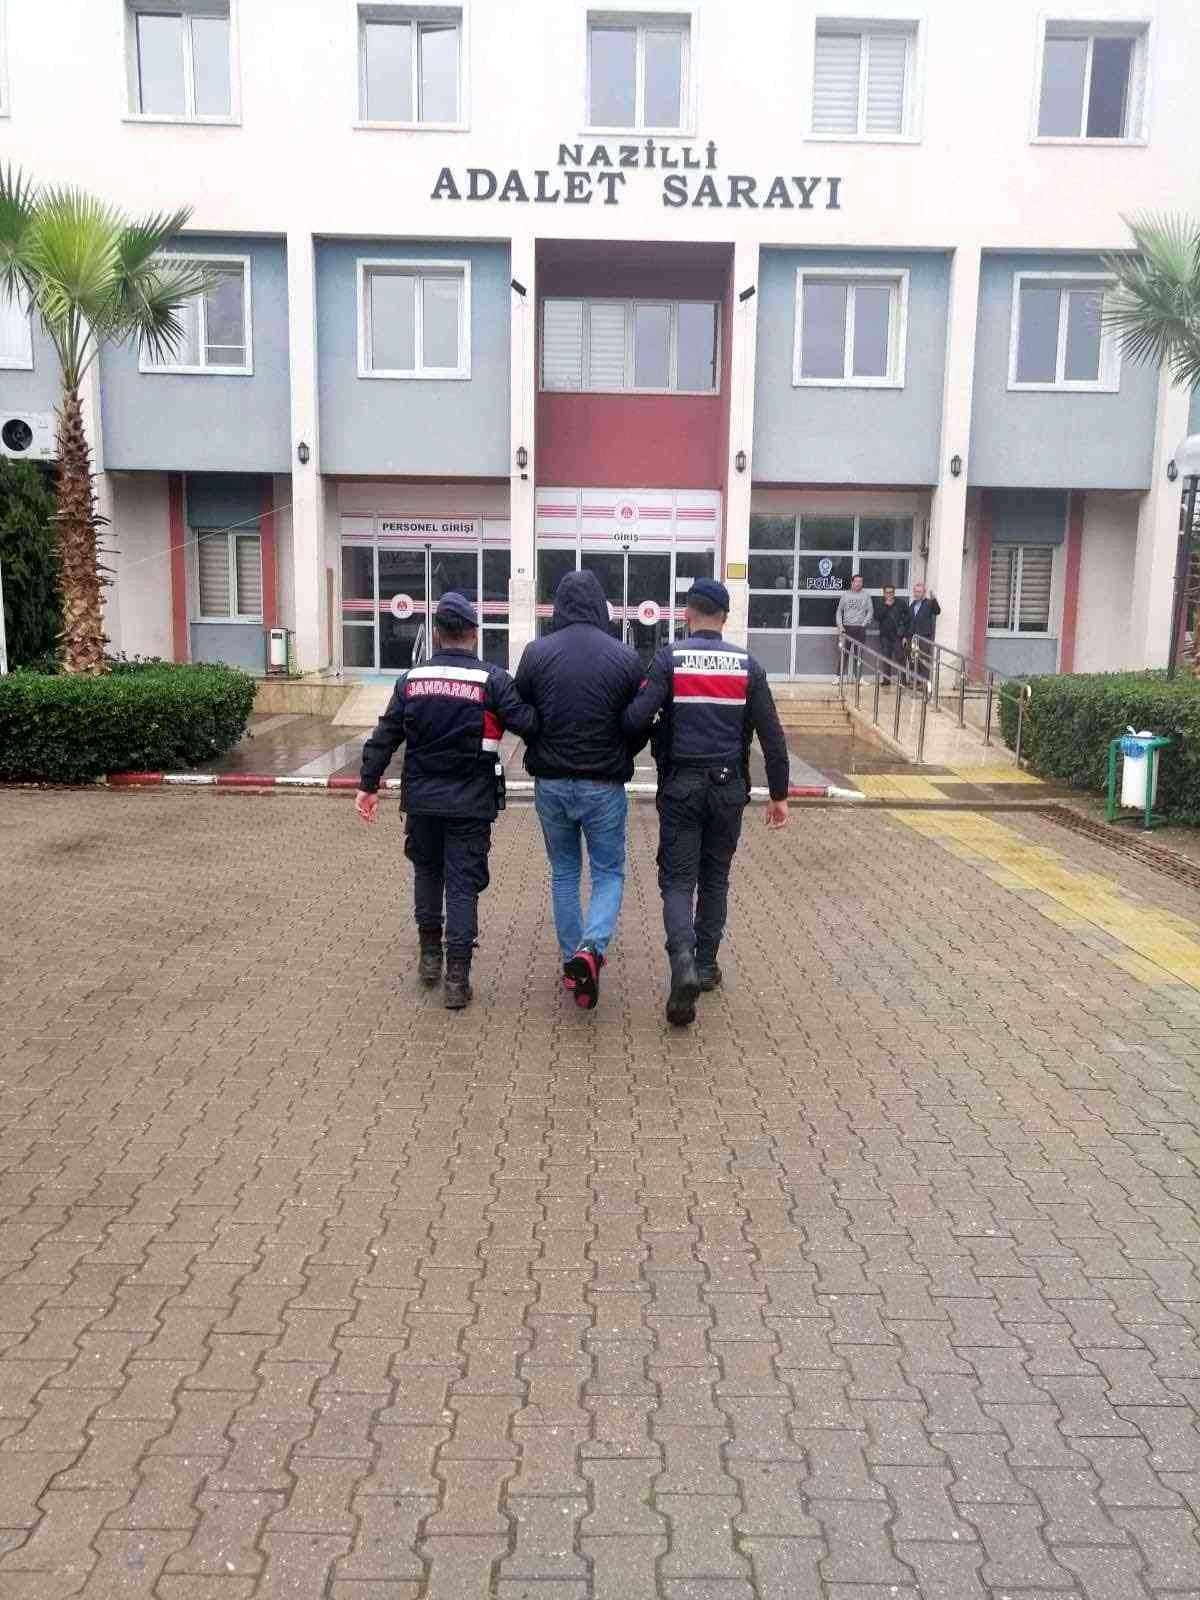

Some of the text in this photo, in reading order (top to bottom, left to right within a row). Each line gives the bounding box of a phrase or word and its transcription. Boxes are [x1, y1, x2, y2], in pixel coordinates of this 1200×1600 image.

[557, 139, 718, 169] NAZİLLİ
[430, 167, 842, 209] ADALET SARAYI
[382, 522, 438, 532] PERSONEL
[681, 655, 741, 671] JANDARMA
[408, 680, 480, 700] JANDARMA
